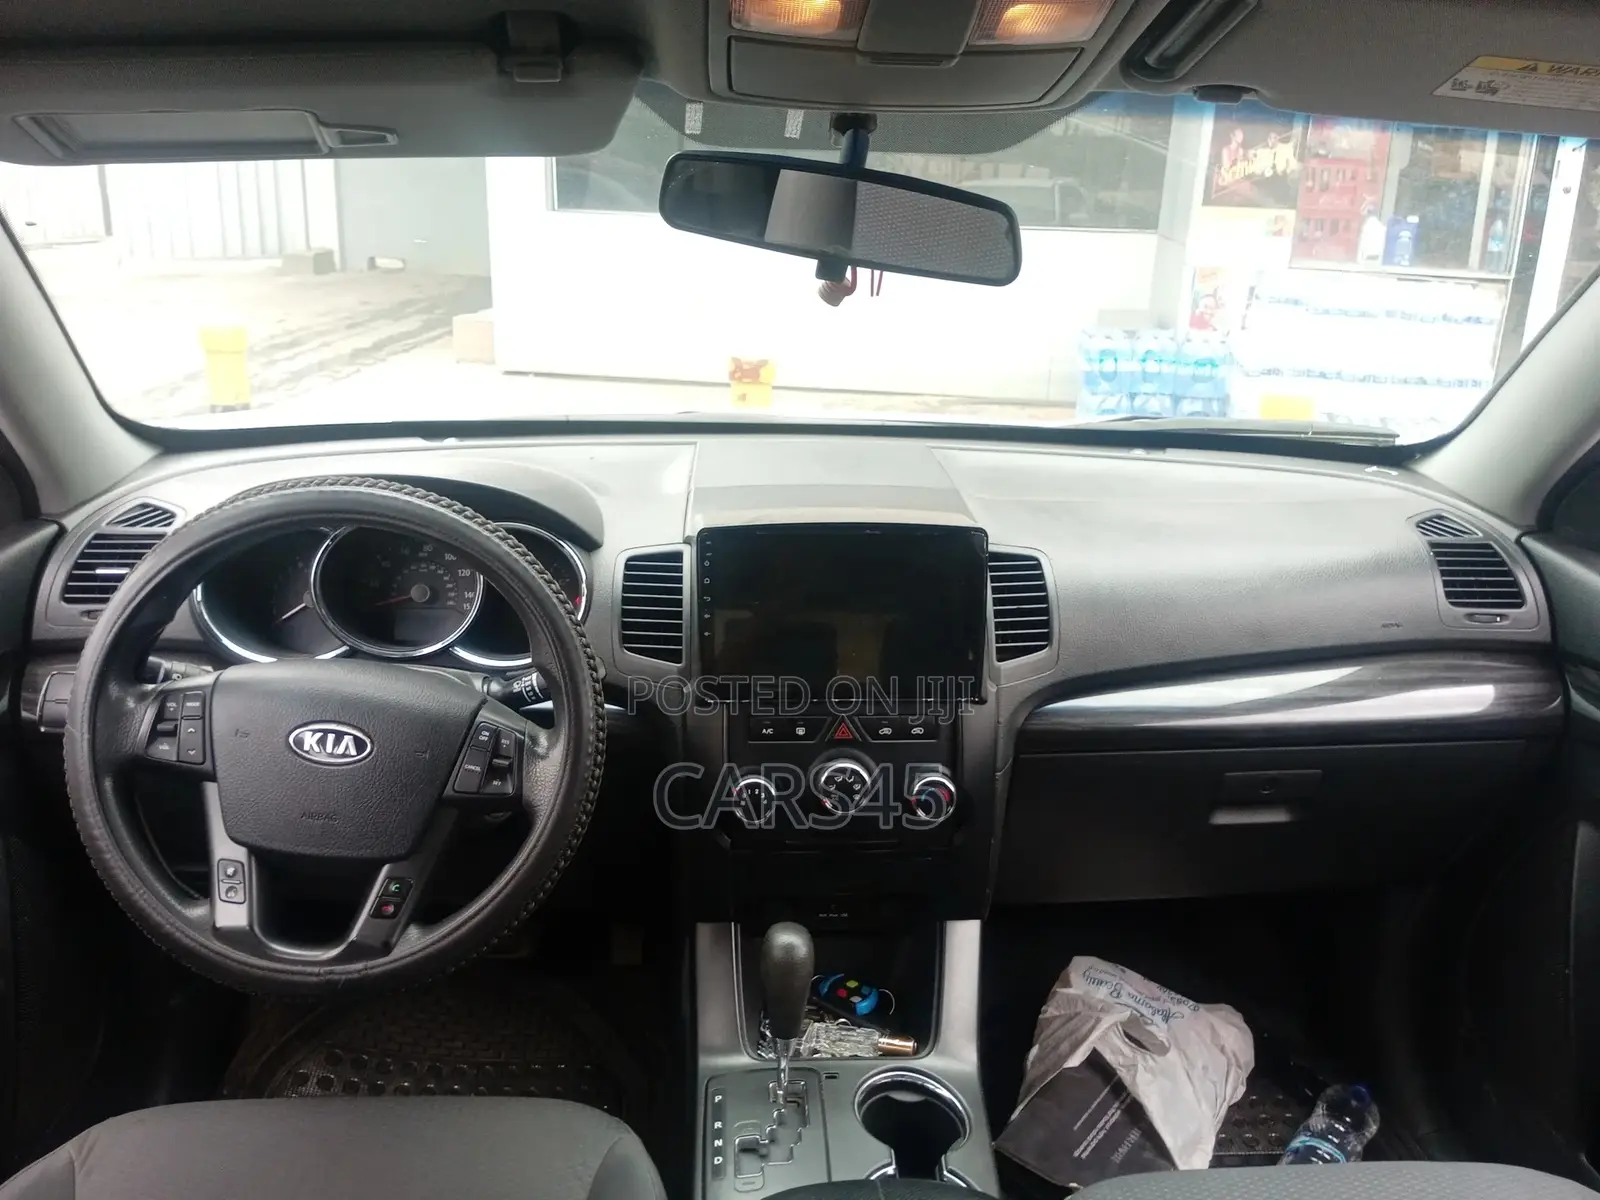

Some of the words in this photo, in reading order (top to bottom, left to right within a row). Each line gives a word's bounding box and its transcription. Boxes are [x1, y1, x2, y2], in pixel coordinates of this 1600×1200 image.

[1547, 63, 1600, 77] WAR
[458, 569, 471, 577] 120
[303, 731, 358, 756] KIA
[715, 1095, 722, 1103] P
[714, 1121, 722, 1129] R
[714, 1138, 723, 1147] N
[714, 1156, 723, 1164] D
